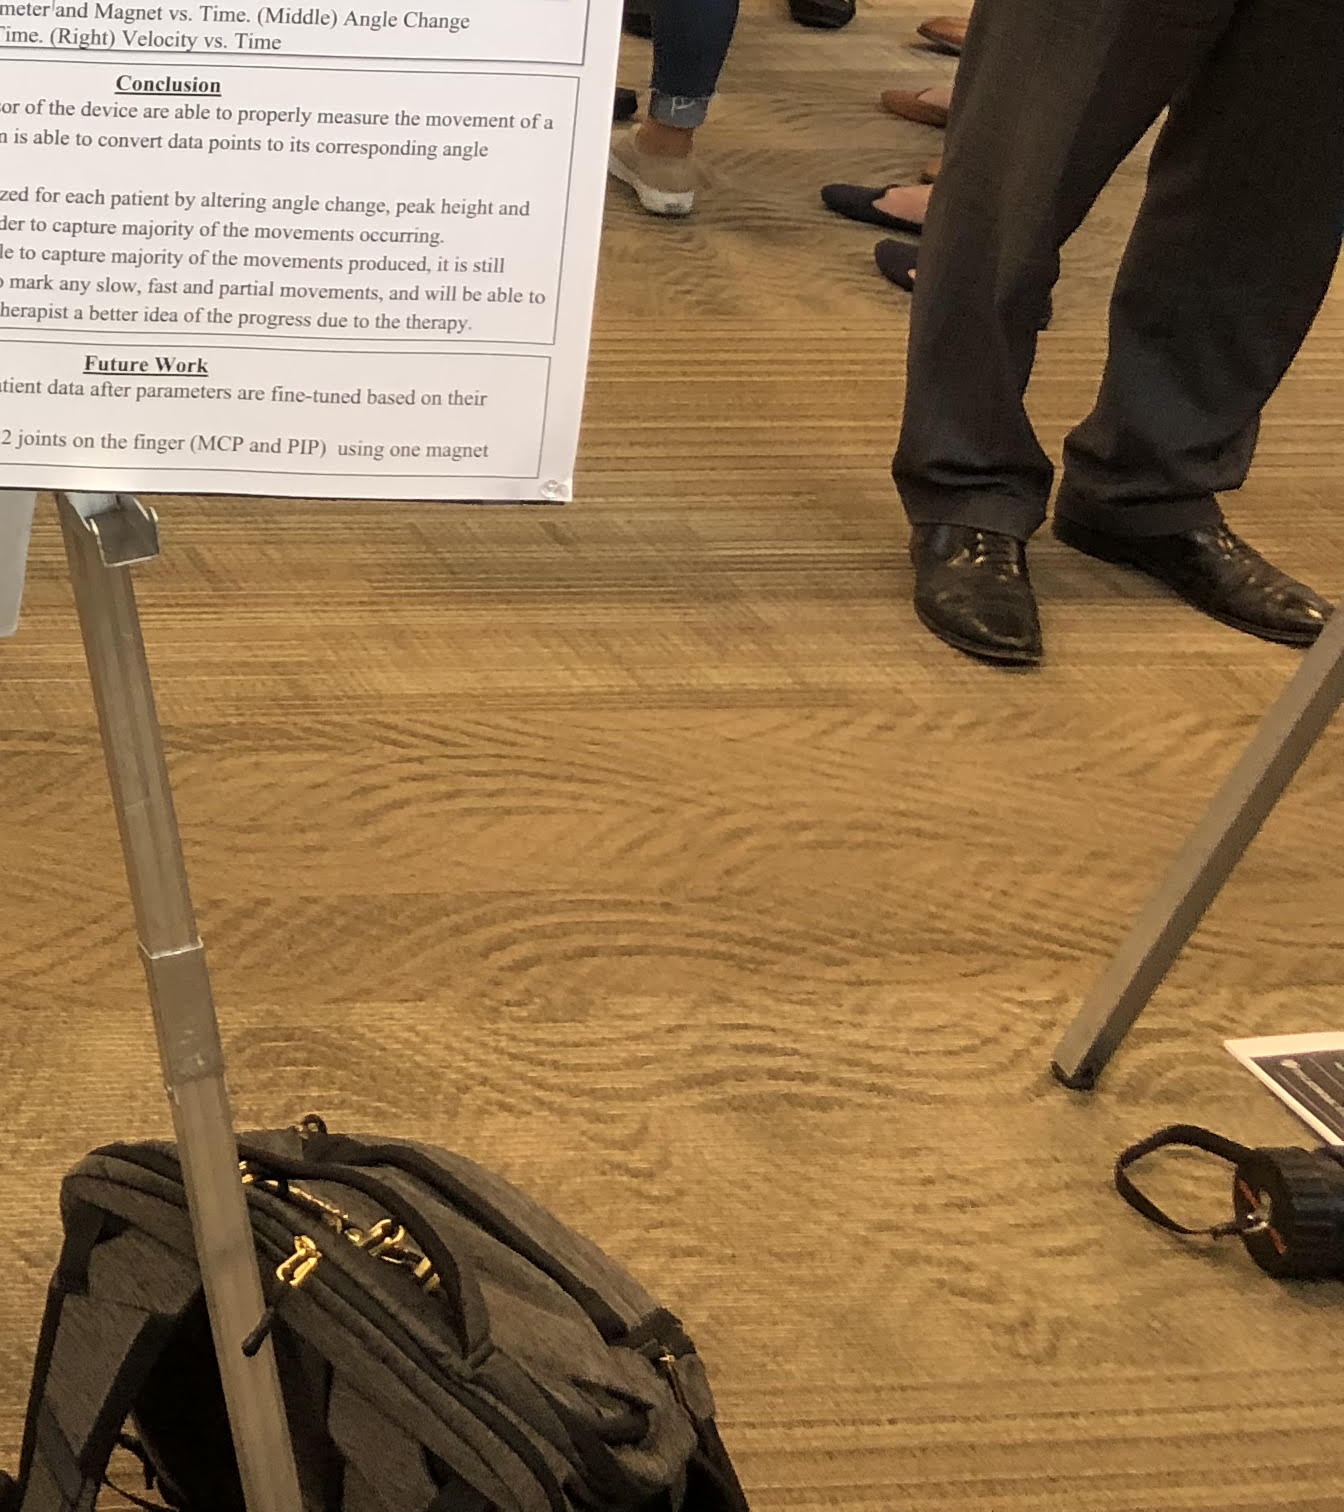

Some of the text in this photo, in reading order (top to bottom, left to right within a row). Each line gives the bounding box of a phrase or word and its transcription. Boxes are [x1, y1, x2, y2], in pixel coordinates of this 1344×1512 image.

[50, 27, 116, 49] (Right)
[122, 29, 198, 52] Velocity
[203, 36, 228, 49] vs.
[234, 32, 282, 50] Time
[116, 74, 221, 93] Conclusion
[84, 355, 209, 374] Future Work
